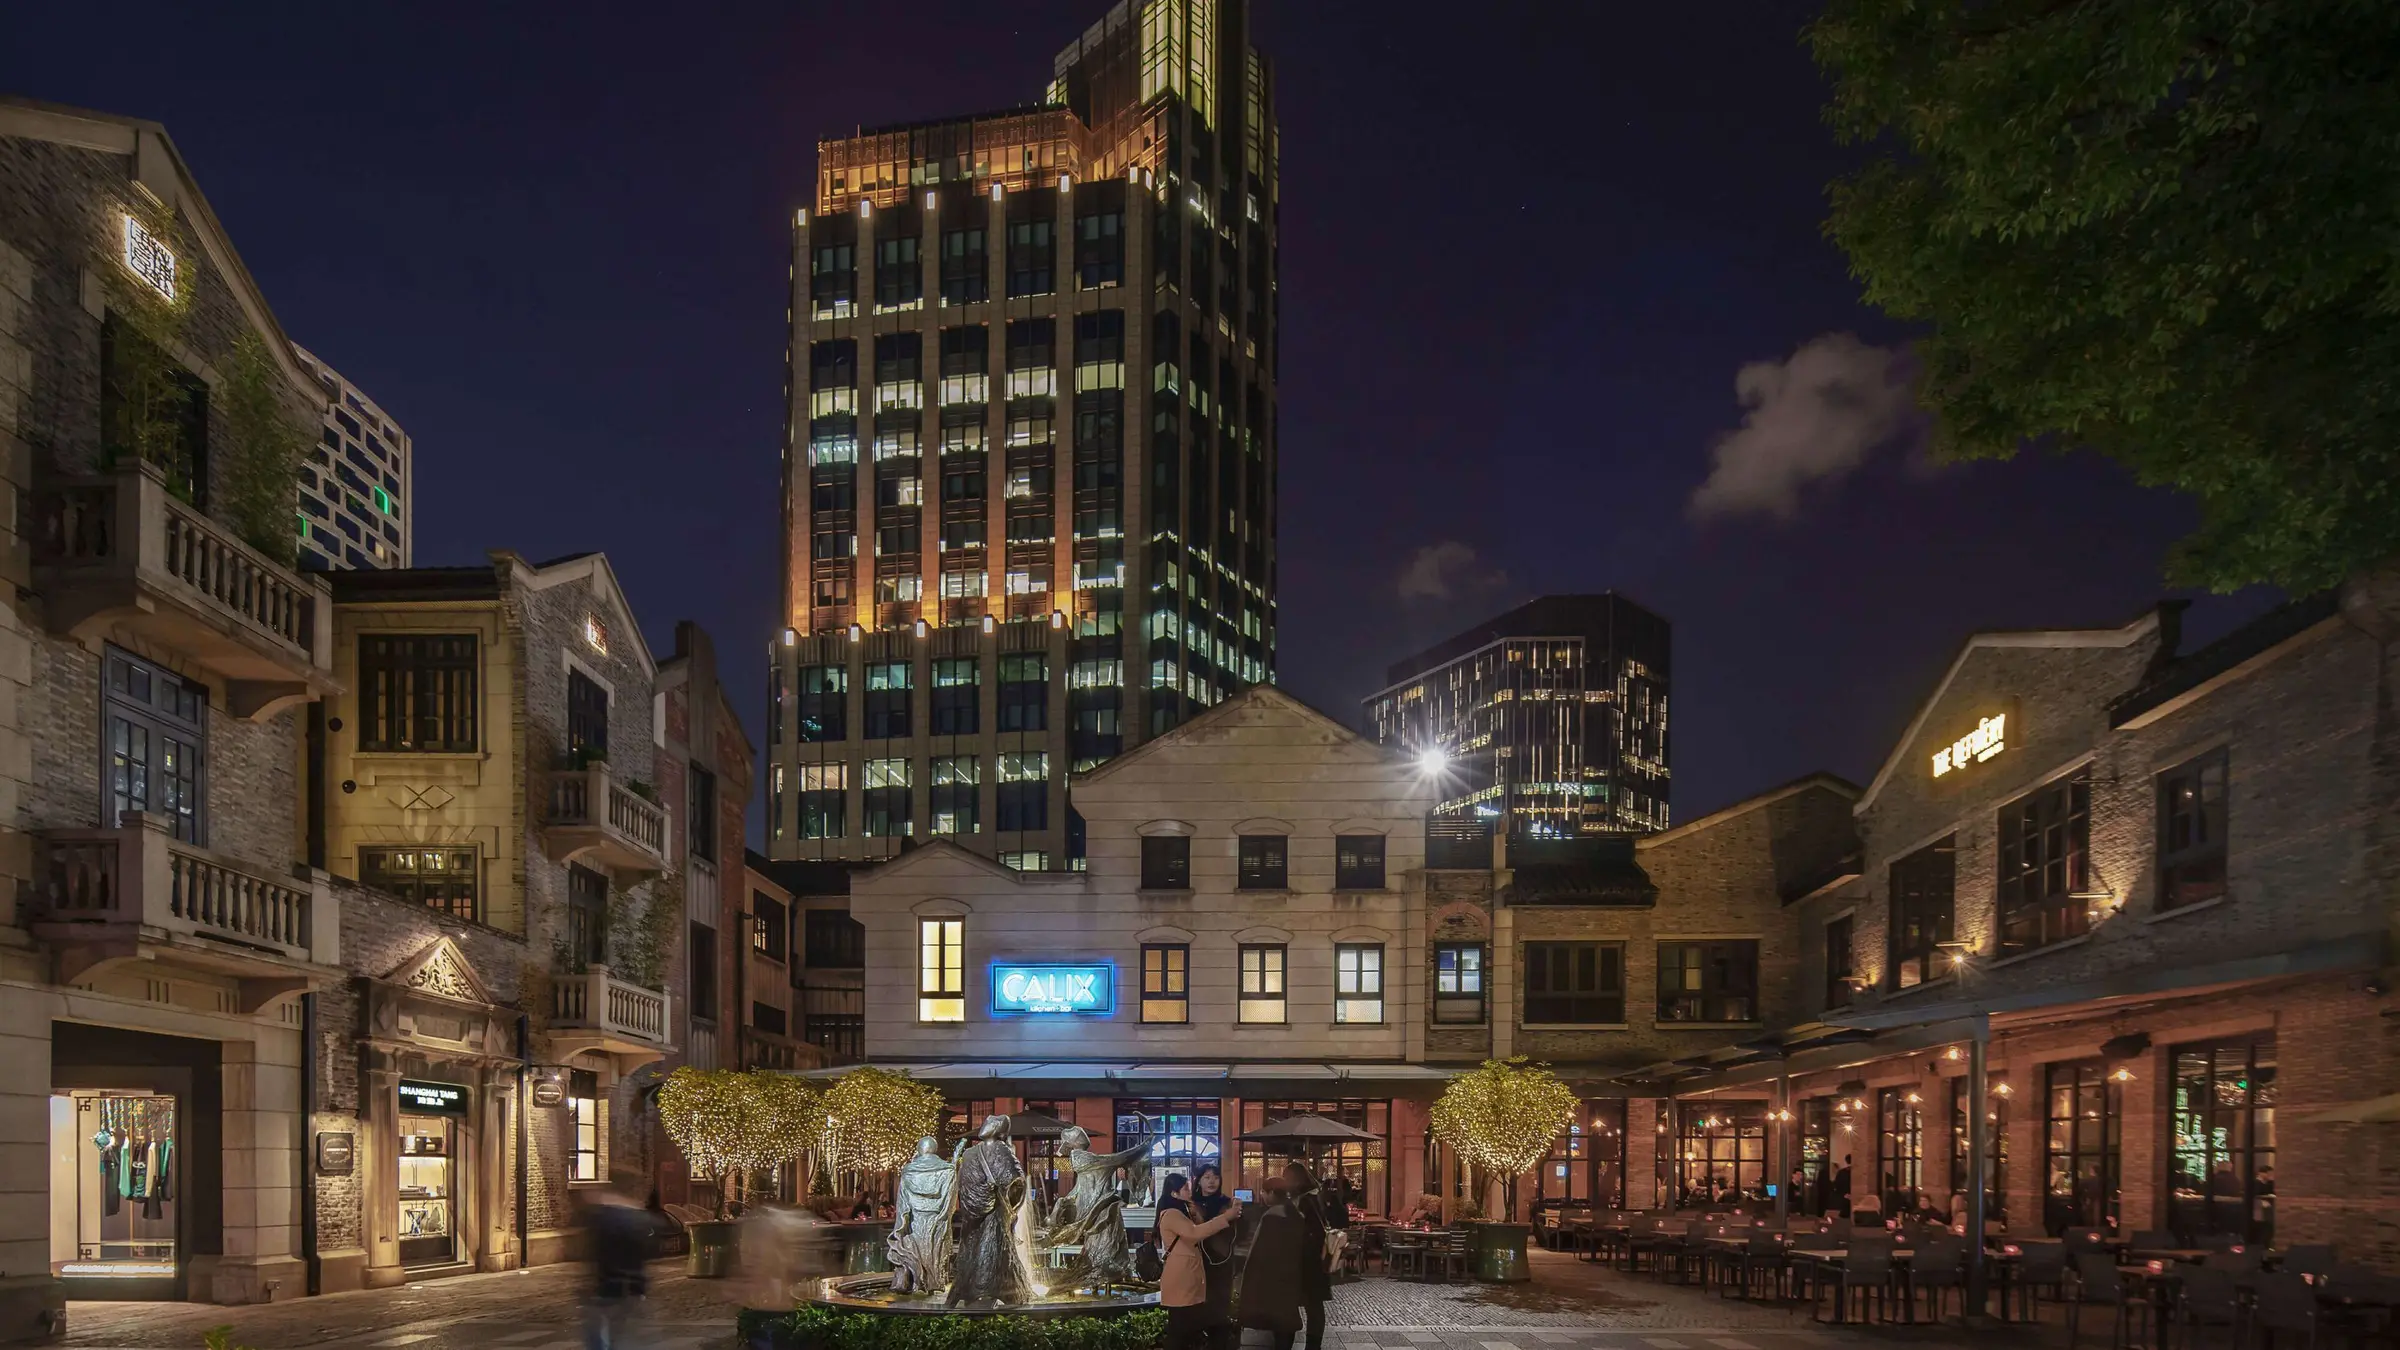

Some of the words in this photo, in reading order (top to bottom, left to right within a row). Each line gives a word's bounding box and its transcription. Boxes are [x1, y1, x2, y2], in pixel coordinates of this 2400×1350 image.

[1002, 973, 1095, 1003] CALIX
[400, 1086, 438, 1098] SHANGHAI
[439, 1090, 458, 1100] TANG
